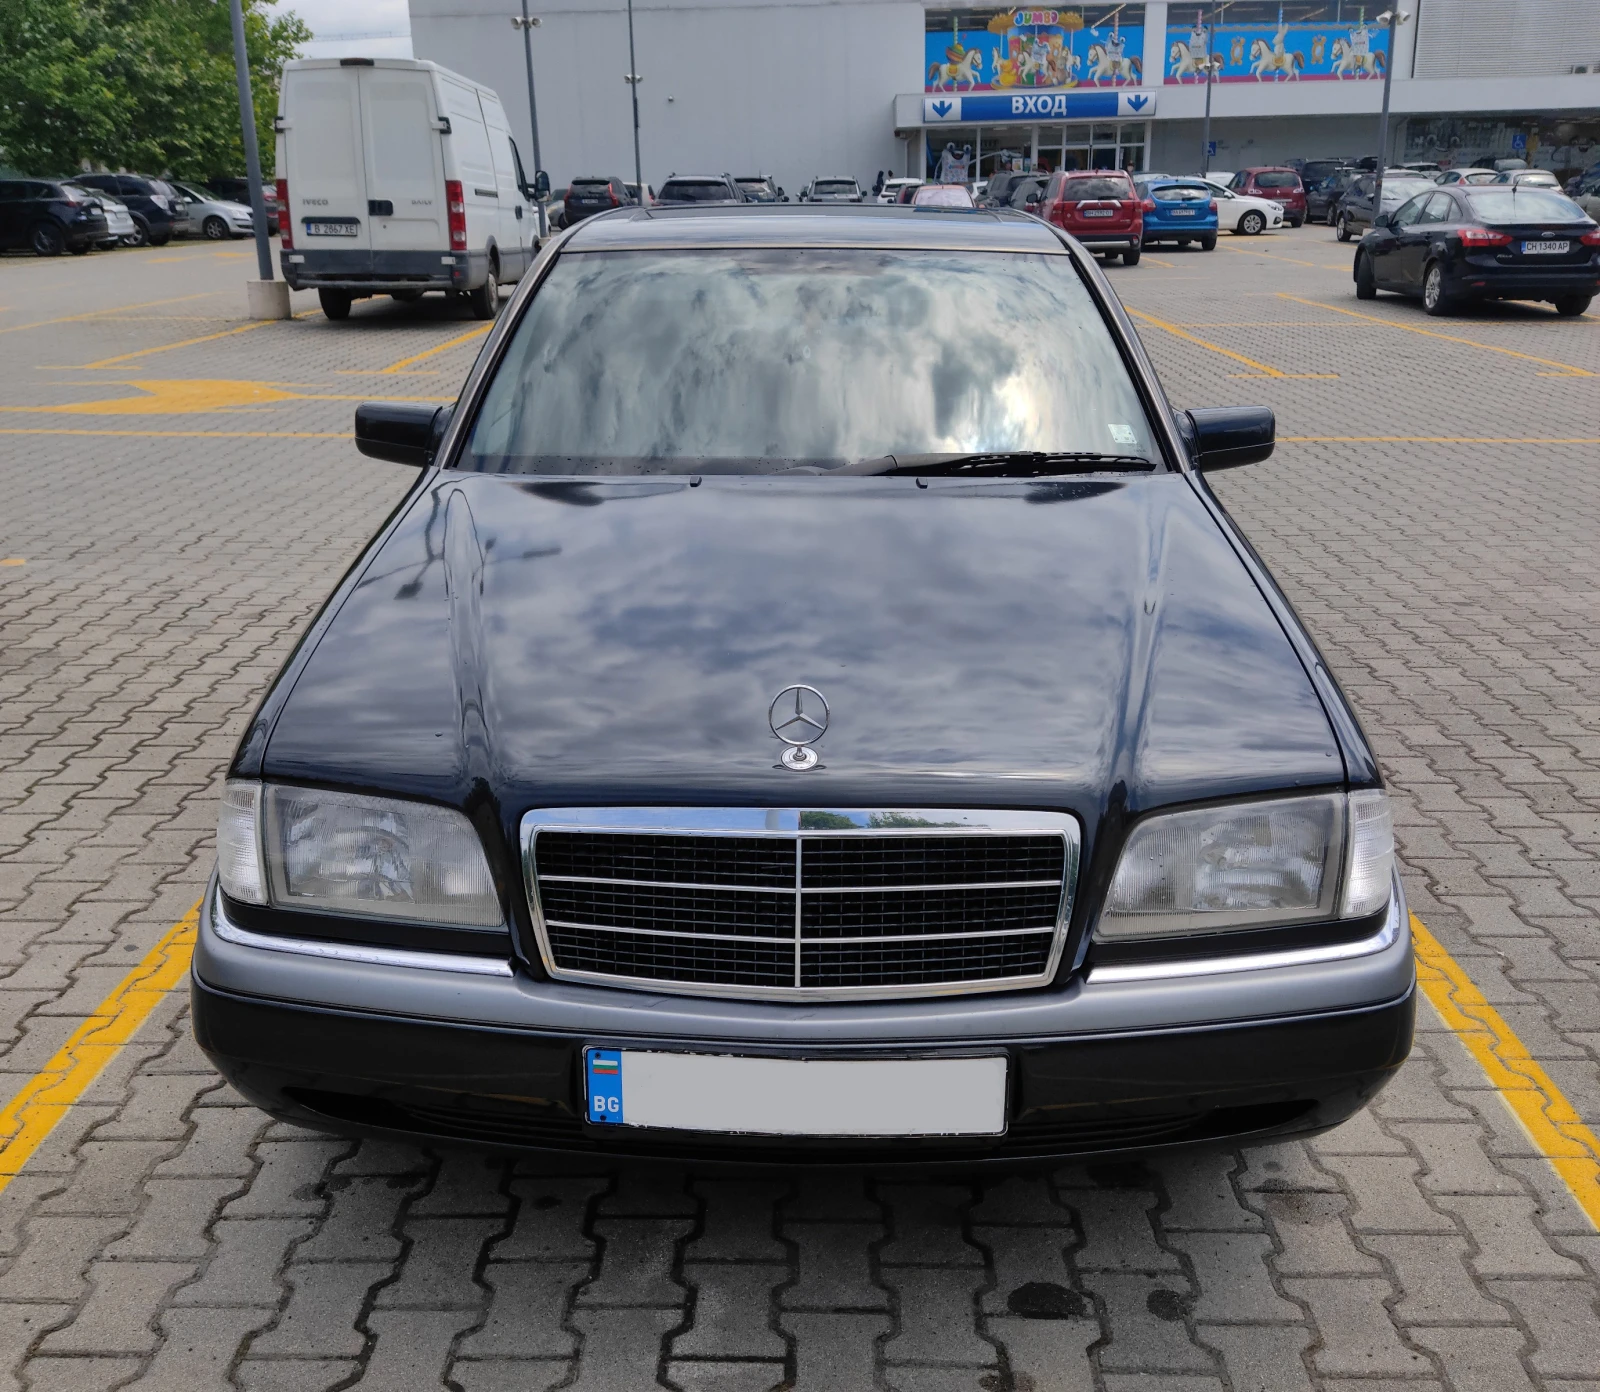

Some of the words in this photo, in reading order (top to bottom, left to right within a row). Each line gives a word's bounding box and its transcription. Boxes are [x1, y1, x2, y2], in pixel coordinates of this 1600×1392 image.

[1014, 10, 1059, 26] JUMBO
[1012, 95, 1067, 117] ВХОД
[302, 198, 329, 206] IVECO
[1539, 242, 1557, 251] 1340
[593, 1095, 619, 1113] BG
